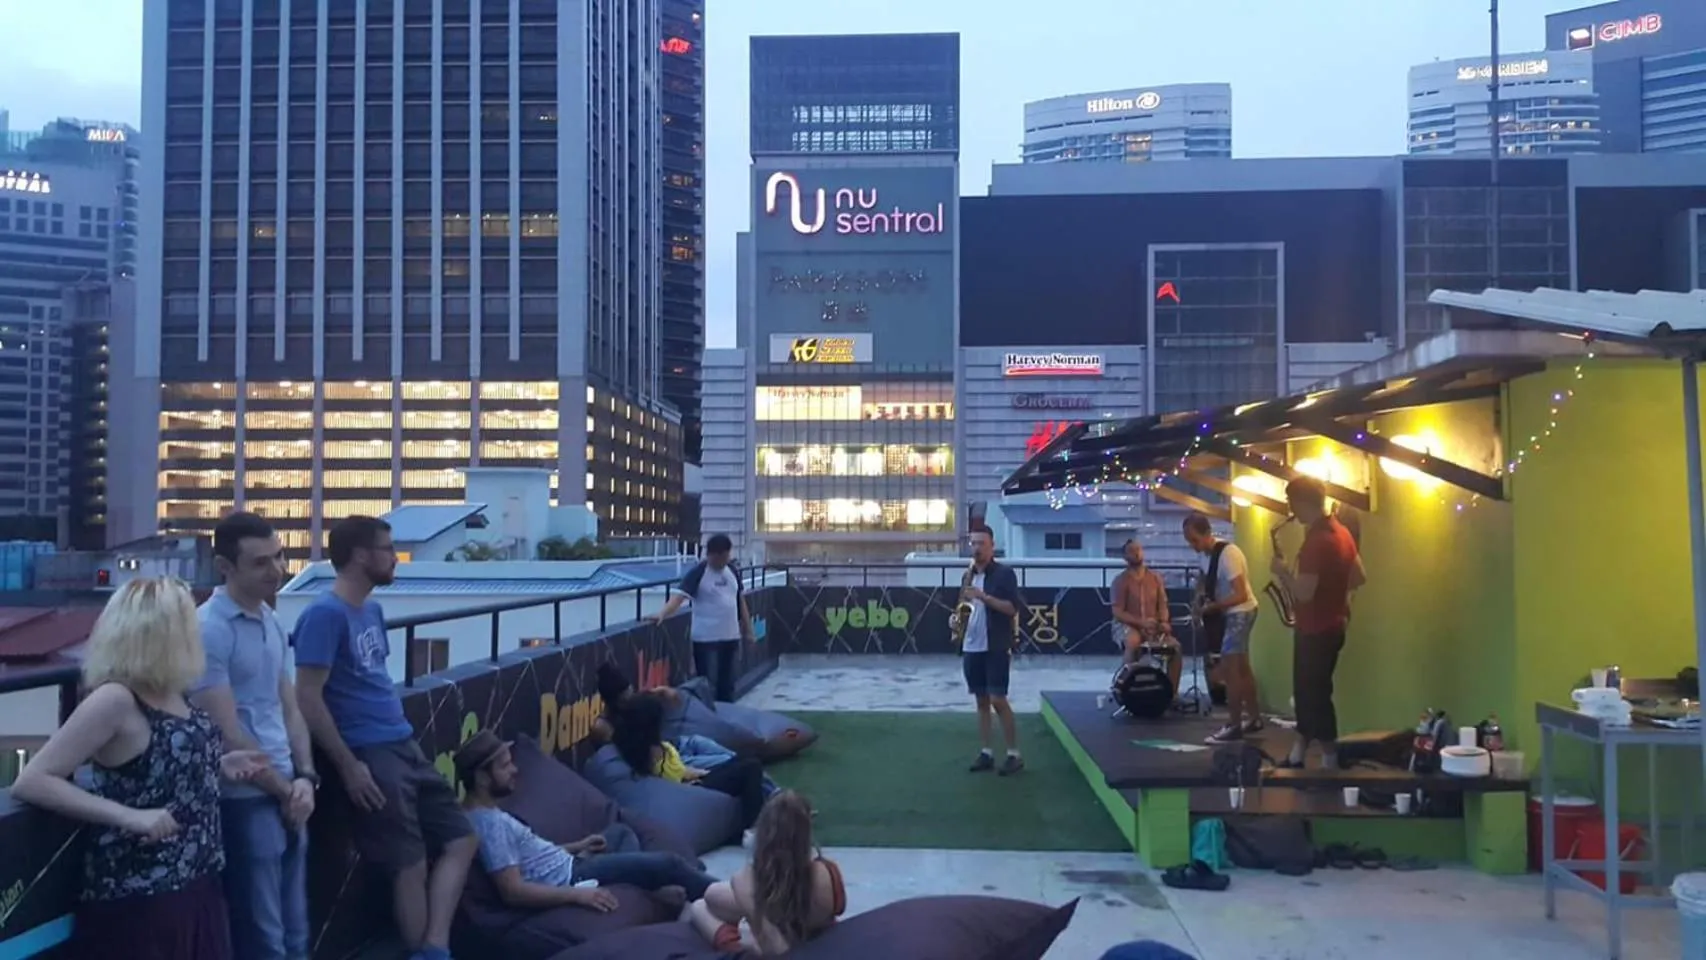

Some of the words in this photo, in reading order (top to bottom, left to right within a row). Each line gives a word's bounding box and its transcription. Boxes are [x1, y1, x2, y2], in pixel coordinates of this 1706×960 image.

[1599, 14, 1661, 41] CIMB
[1087, 98, 1133, 113] Hilton
[835, 188, 877, 208] nu
[836, 202, 943, 233] sentral
[1007, 354, 1050, 366] Harvey
[1051, 354, 1100, 365] Norman
[826, 600, 910, 635] yebo
[1014, 603, 1058, 643] 정
